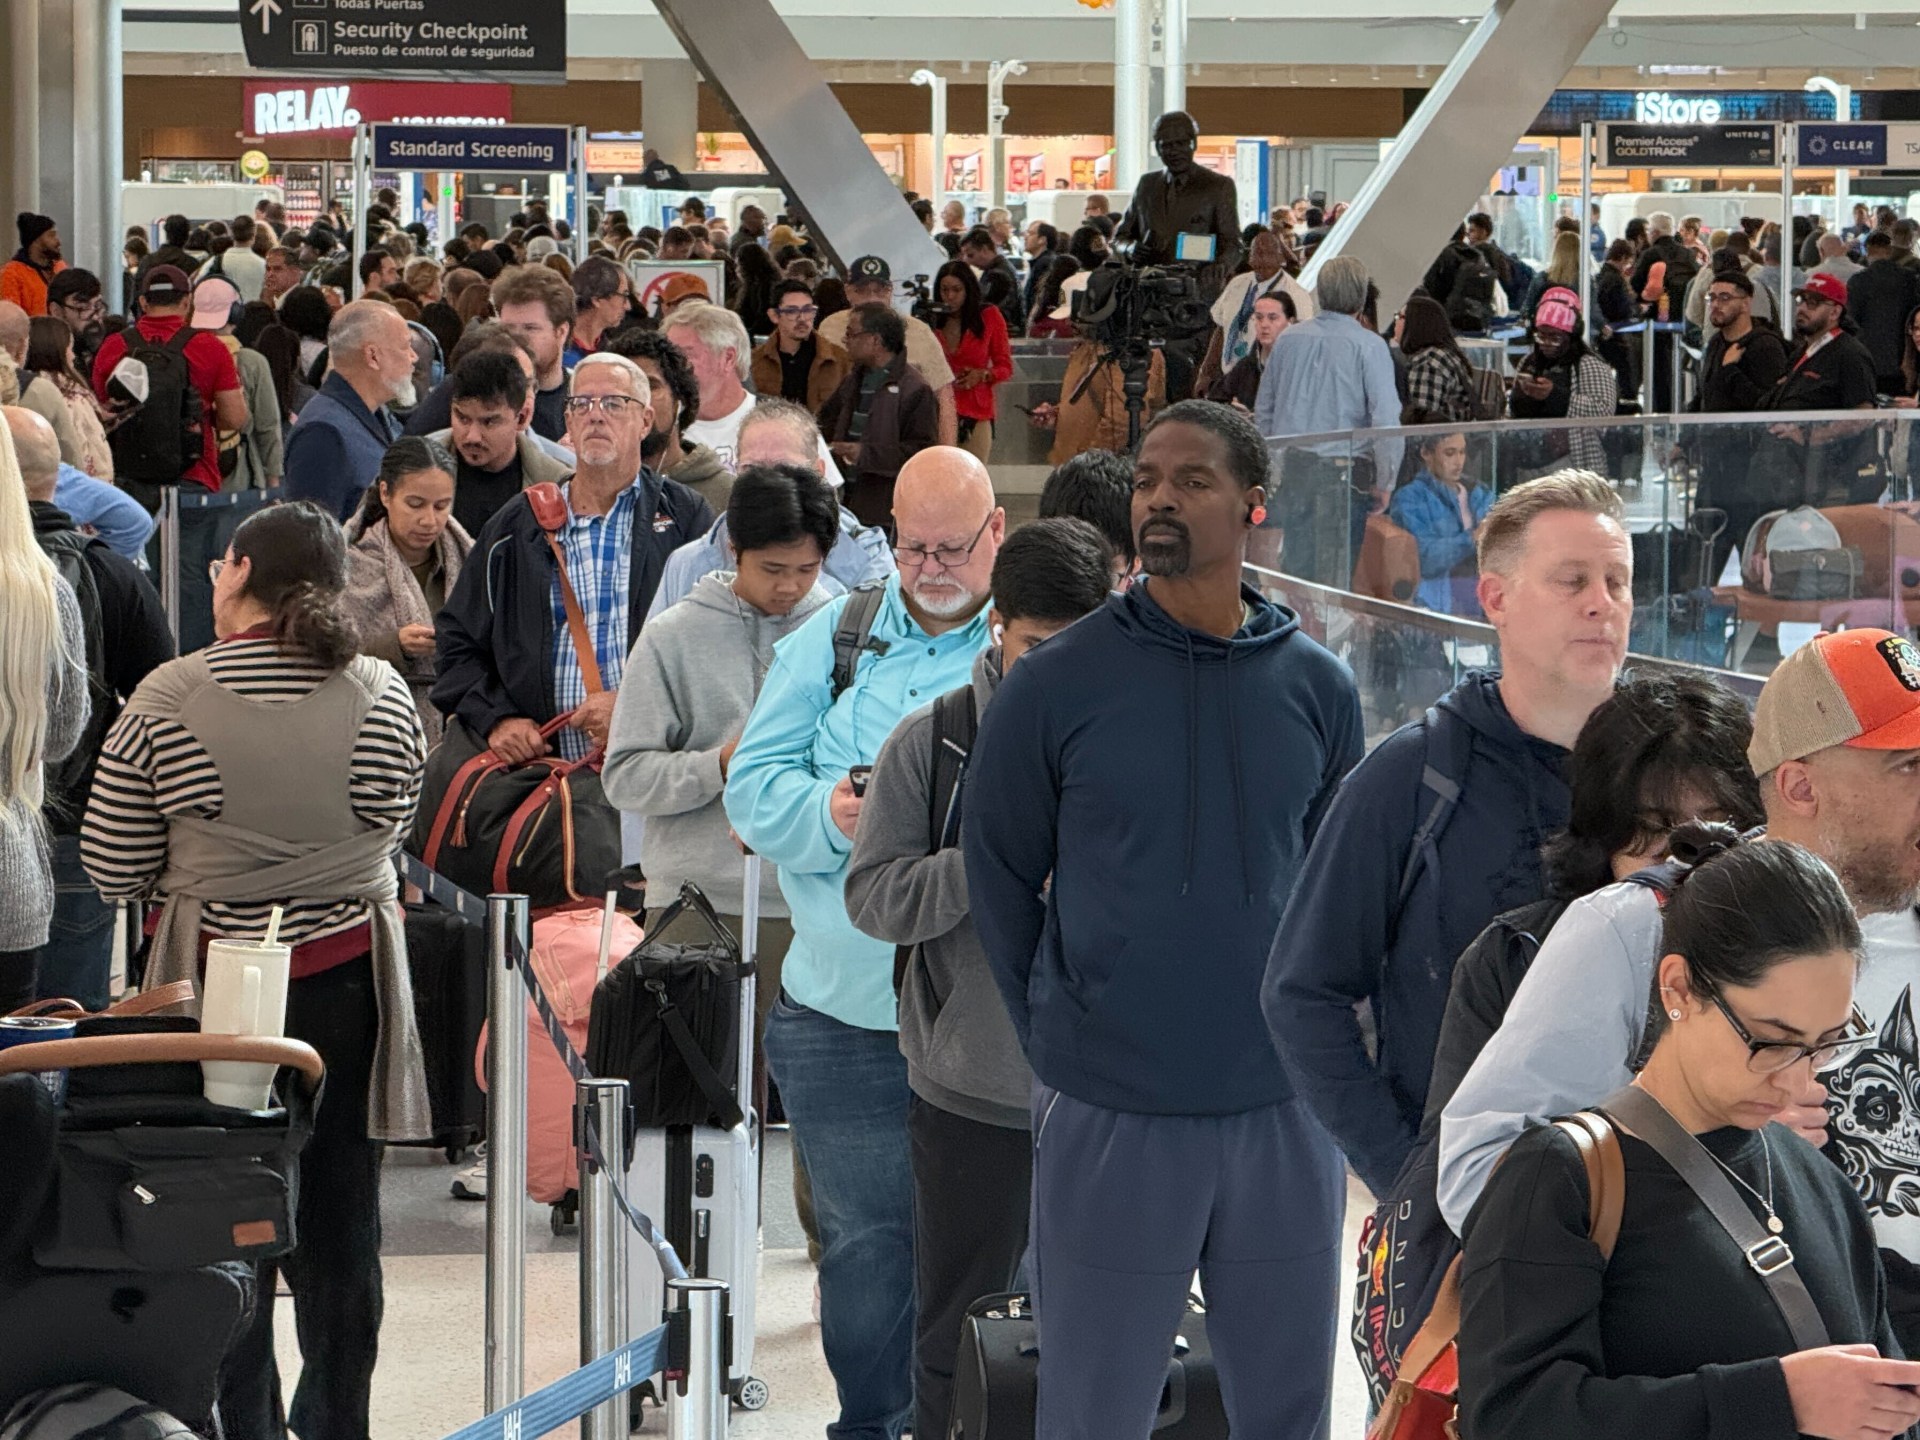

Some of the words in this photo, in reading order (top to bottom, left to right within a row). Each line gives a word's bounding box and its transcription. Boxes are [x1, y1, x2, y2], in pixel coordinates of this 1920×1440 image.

[334, 0, 371, 9] Todas
[374, 0, 425, 10] Puertas
[334, 21, 414, 43] Security
[419, 22, 528, 44] Checkpoint
[334, 44, 378, 56] Puesto
[382, 45, 398, 57] de
[401, 45, 448, 57] control
[451, 45, 467, 58] de
[471, 46, 535, 60] seguridad
[1635, 91, 1721, 124] iStore
[1615, 135, 1655, 147] Premier
[1725, 131, 1760, 139] UNITED
[390, 140, 465, 158] Standard
[470, 142, 554, 161] Screening
[1615, 146, 1687, 158] GOLDTRACK
[1832, 140, 1874, 150] CLEAR
[1369, 1304, 1387, 1362] Bull
[614, 1350, 632, 1390] IAH
